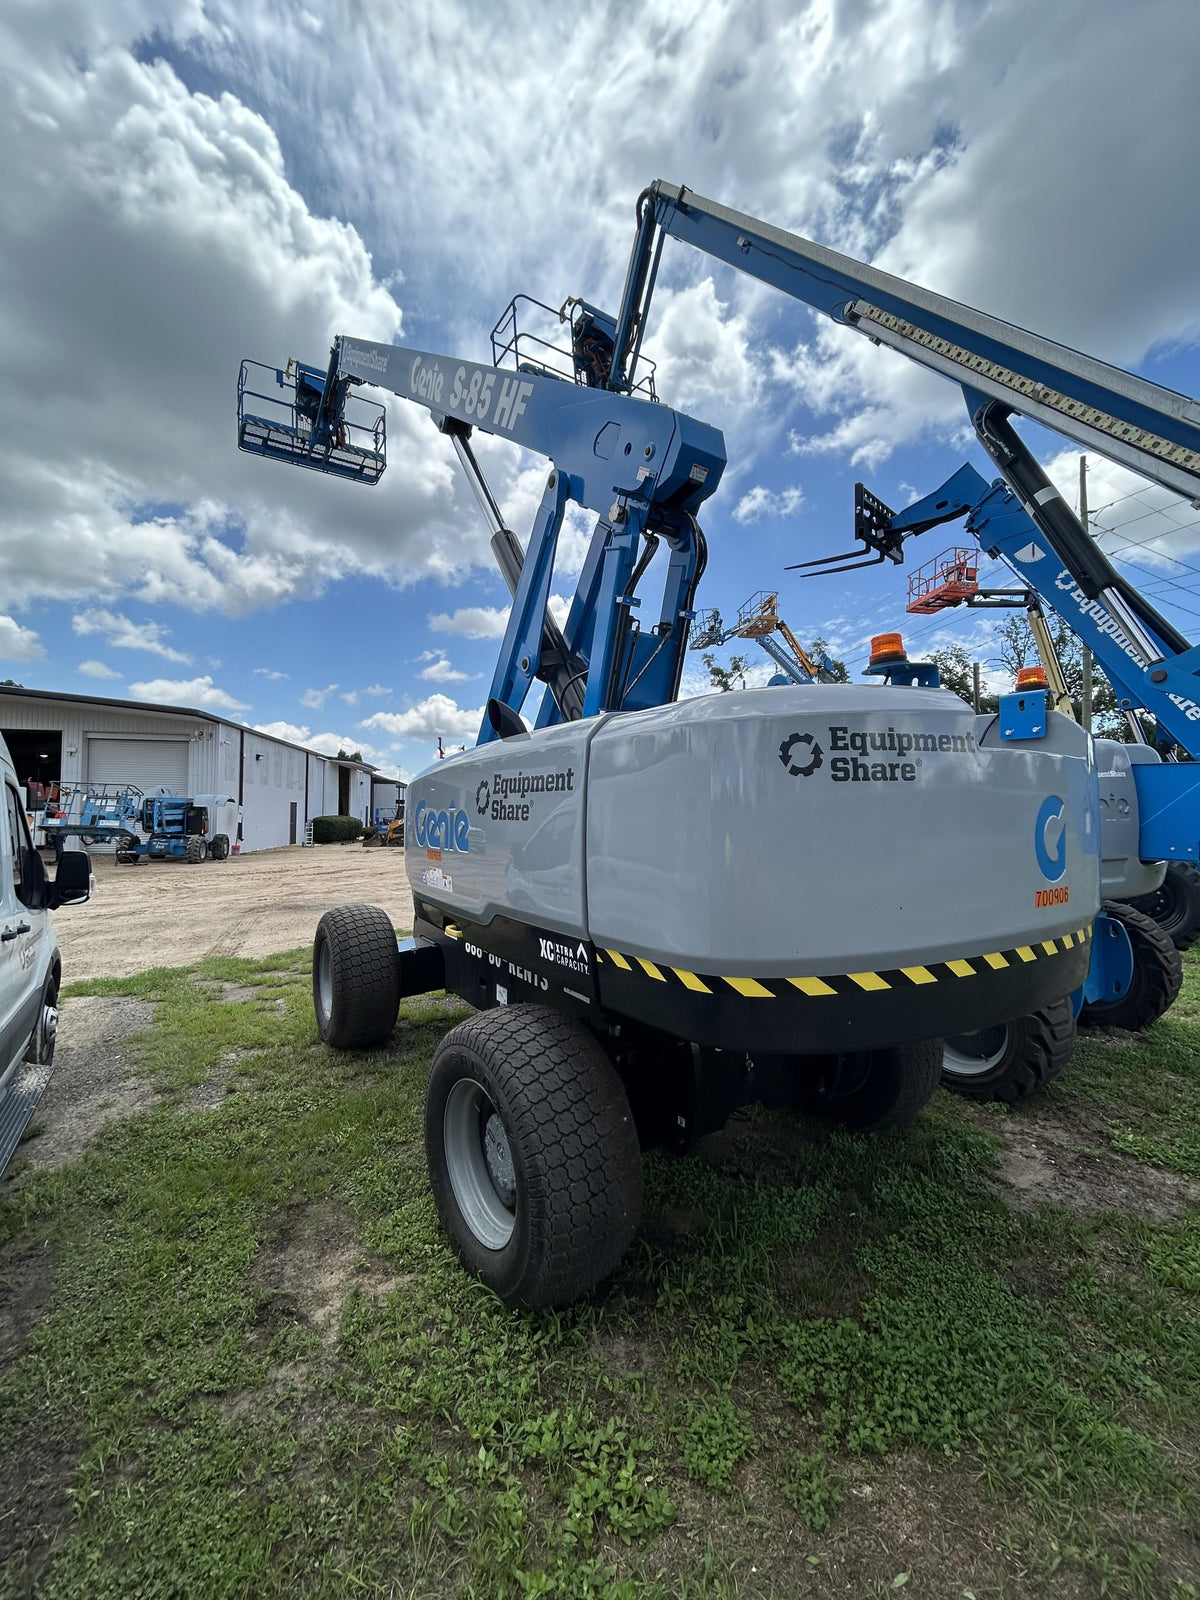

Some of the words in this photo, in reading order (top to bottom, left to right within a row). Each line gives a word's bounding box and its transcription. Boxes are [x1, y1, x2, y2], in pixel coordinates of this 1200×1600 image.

[411, 356, 444, 403] Genie
[450, 366, 497, 419] S-85
[493, 377, 535, 431] HF
[829, 726, 976, 757] Equipment
[493, 767, 575, 799] Equipment
[415, 799, 470, 854] Genie
[1036, 886, 1069, 908] 700906
[539, 937, 555, 962] XC
[555, 943, 574, 959] XTRA
